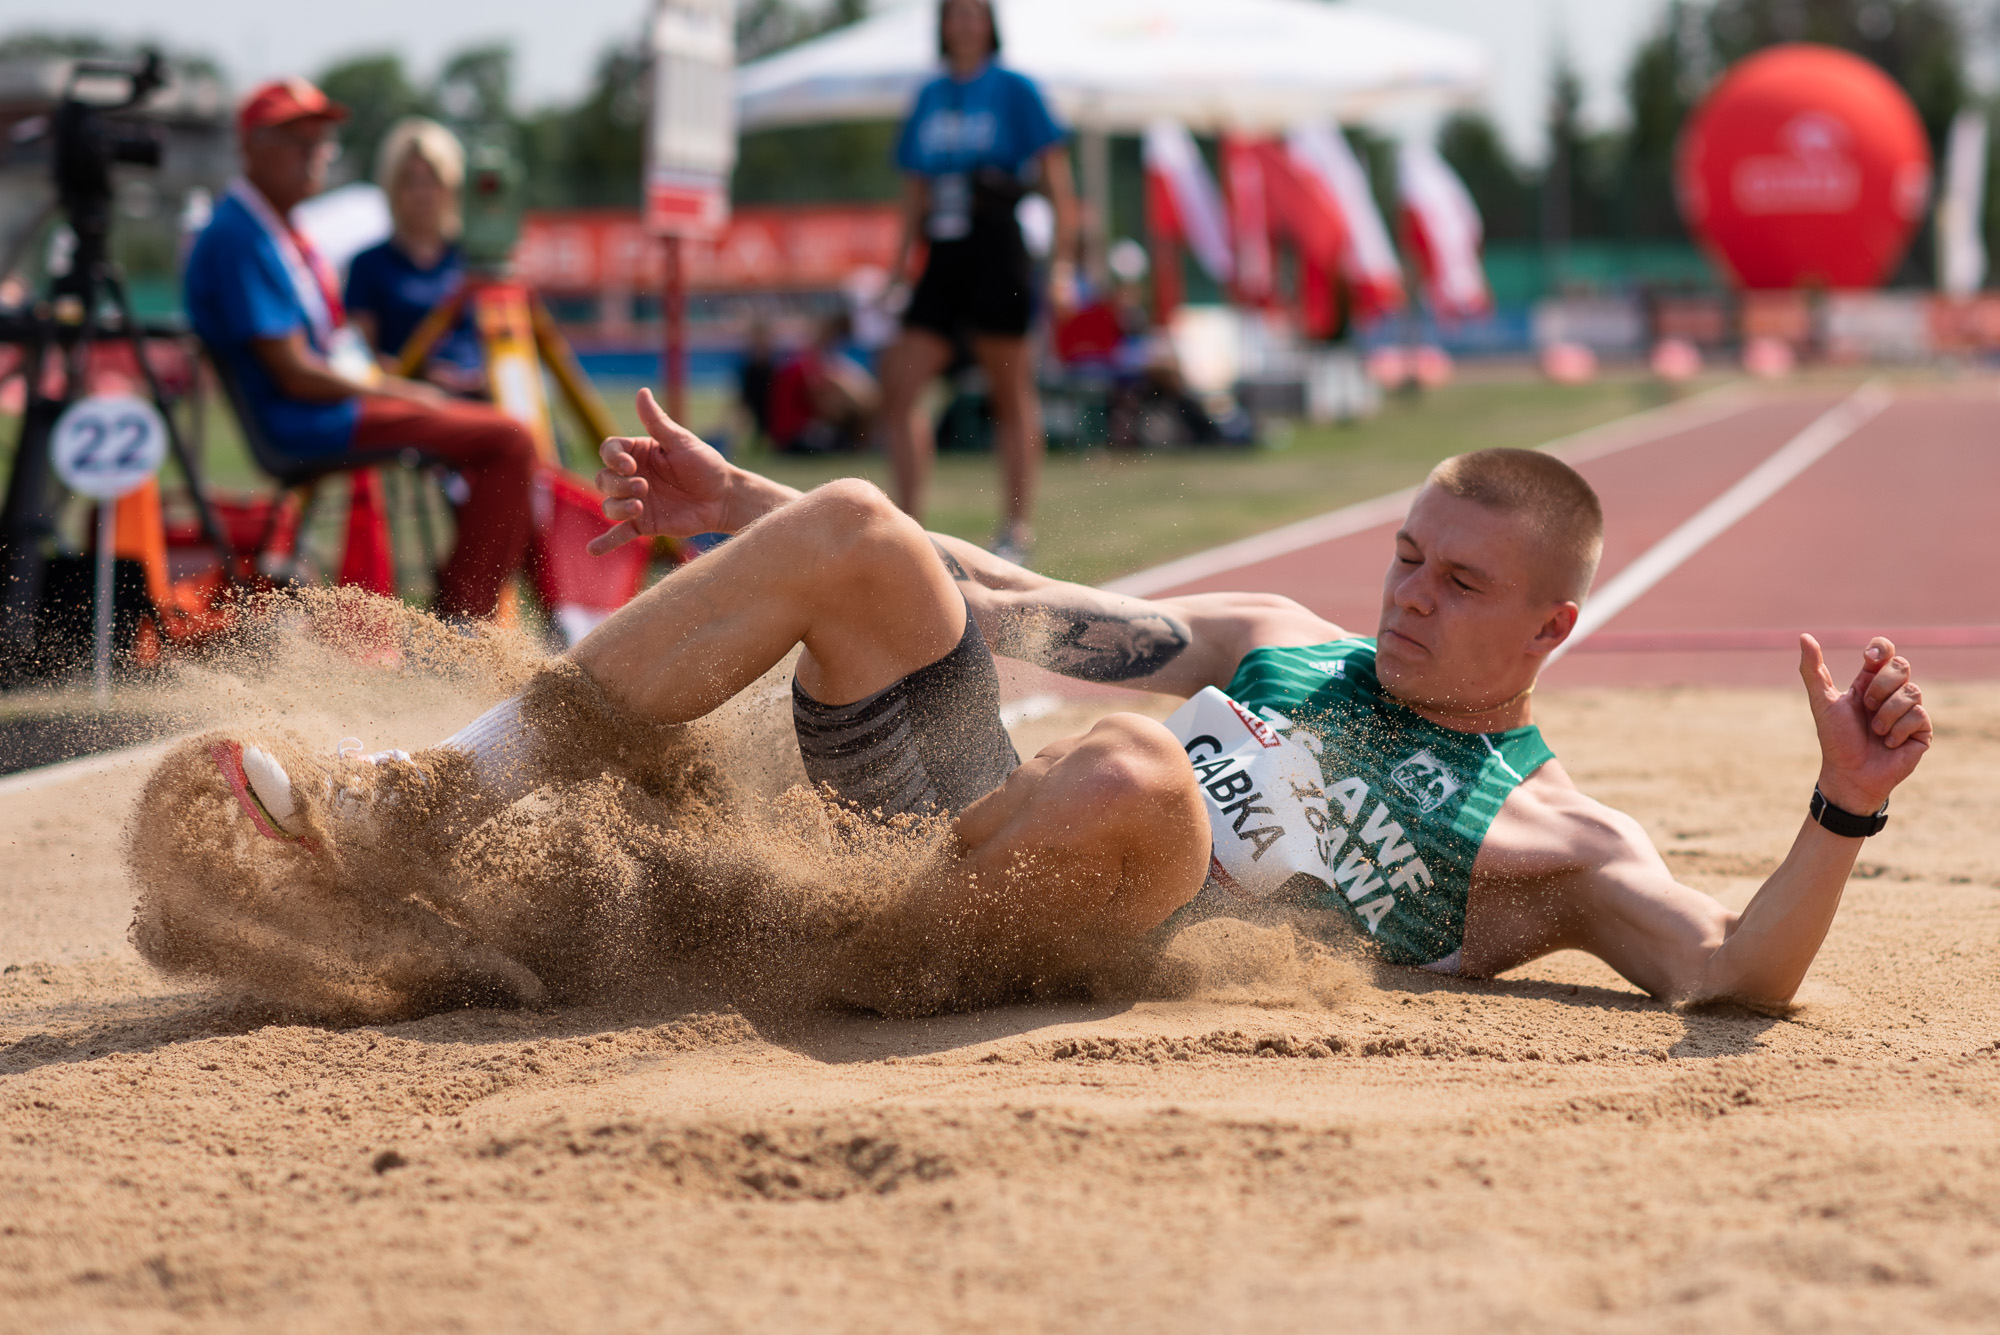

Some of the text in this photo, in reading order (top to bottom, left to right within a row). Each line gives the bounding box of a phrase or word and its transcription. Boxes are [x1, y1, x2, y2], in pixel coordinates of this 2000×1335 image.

[71, 414, 149, 471] 22
[1184, 734, 1286, 862] GABKA
[1325, 776, 1432, 894] AWF
